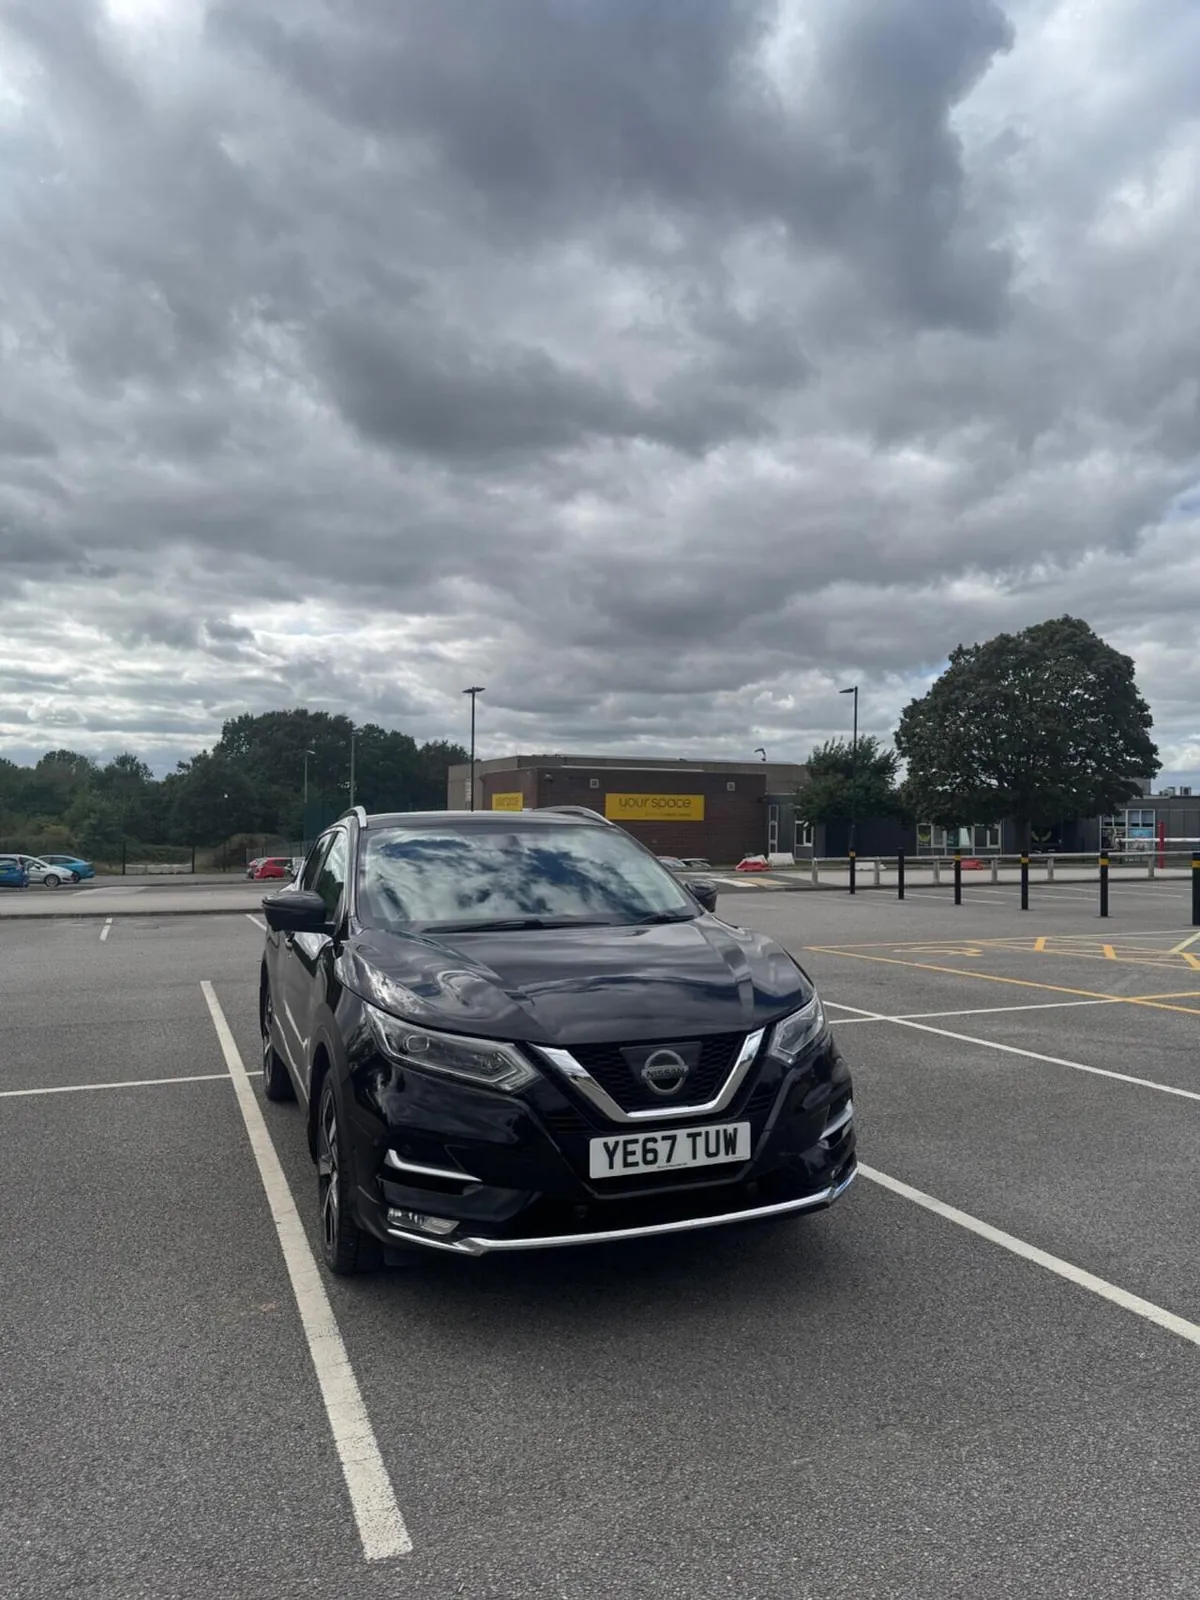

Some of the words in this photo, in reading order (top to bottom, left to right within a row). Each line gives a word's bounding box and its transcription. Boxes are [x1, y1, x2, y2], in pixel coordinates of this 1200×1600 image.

[646, 1068, 685, 1078] NISSAN
[603, 1134, 678, 1170] YE67
[686, 1127, 738, 1161] TUW
